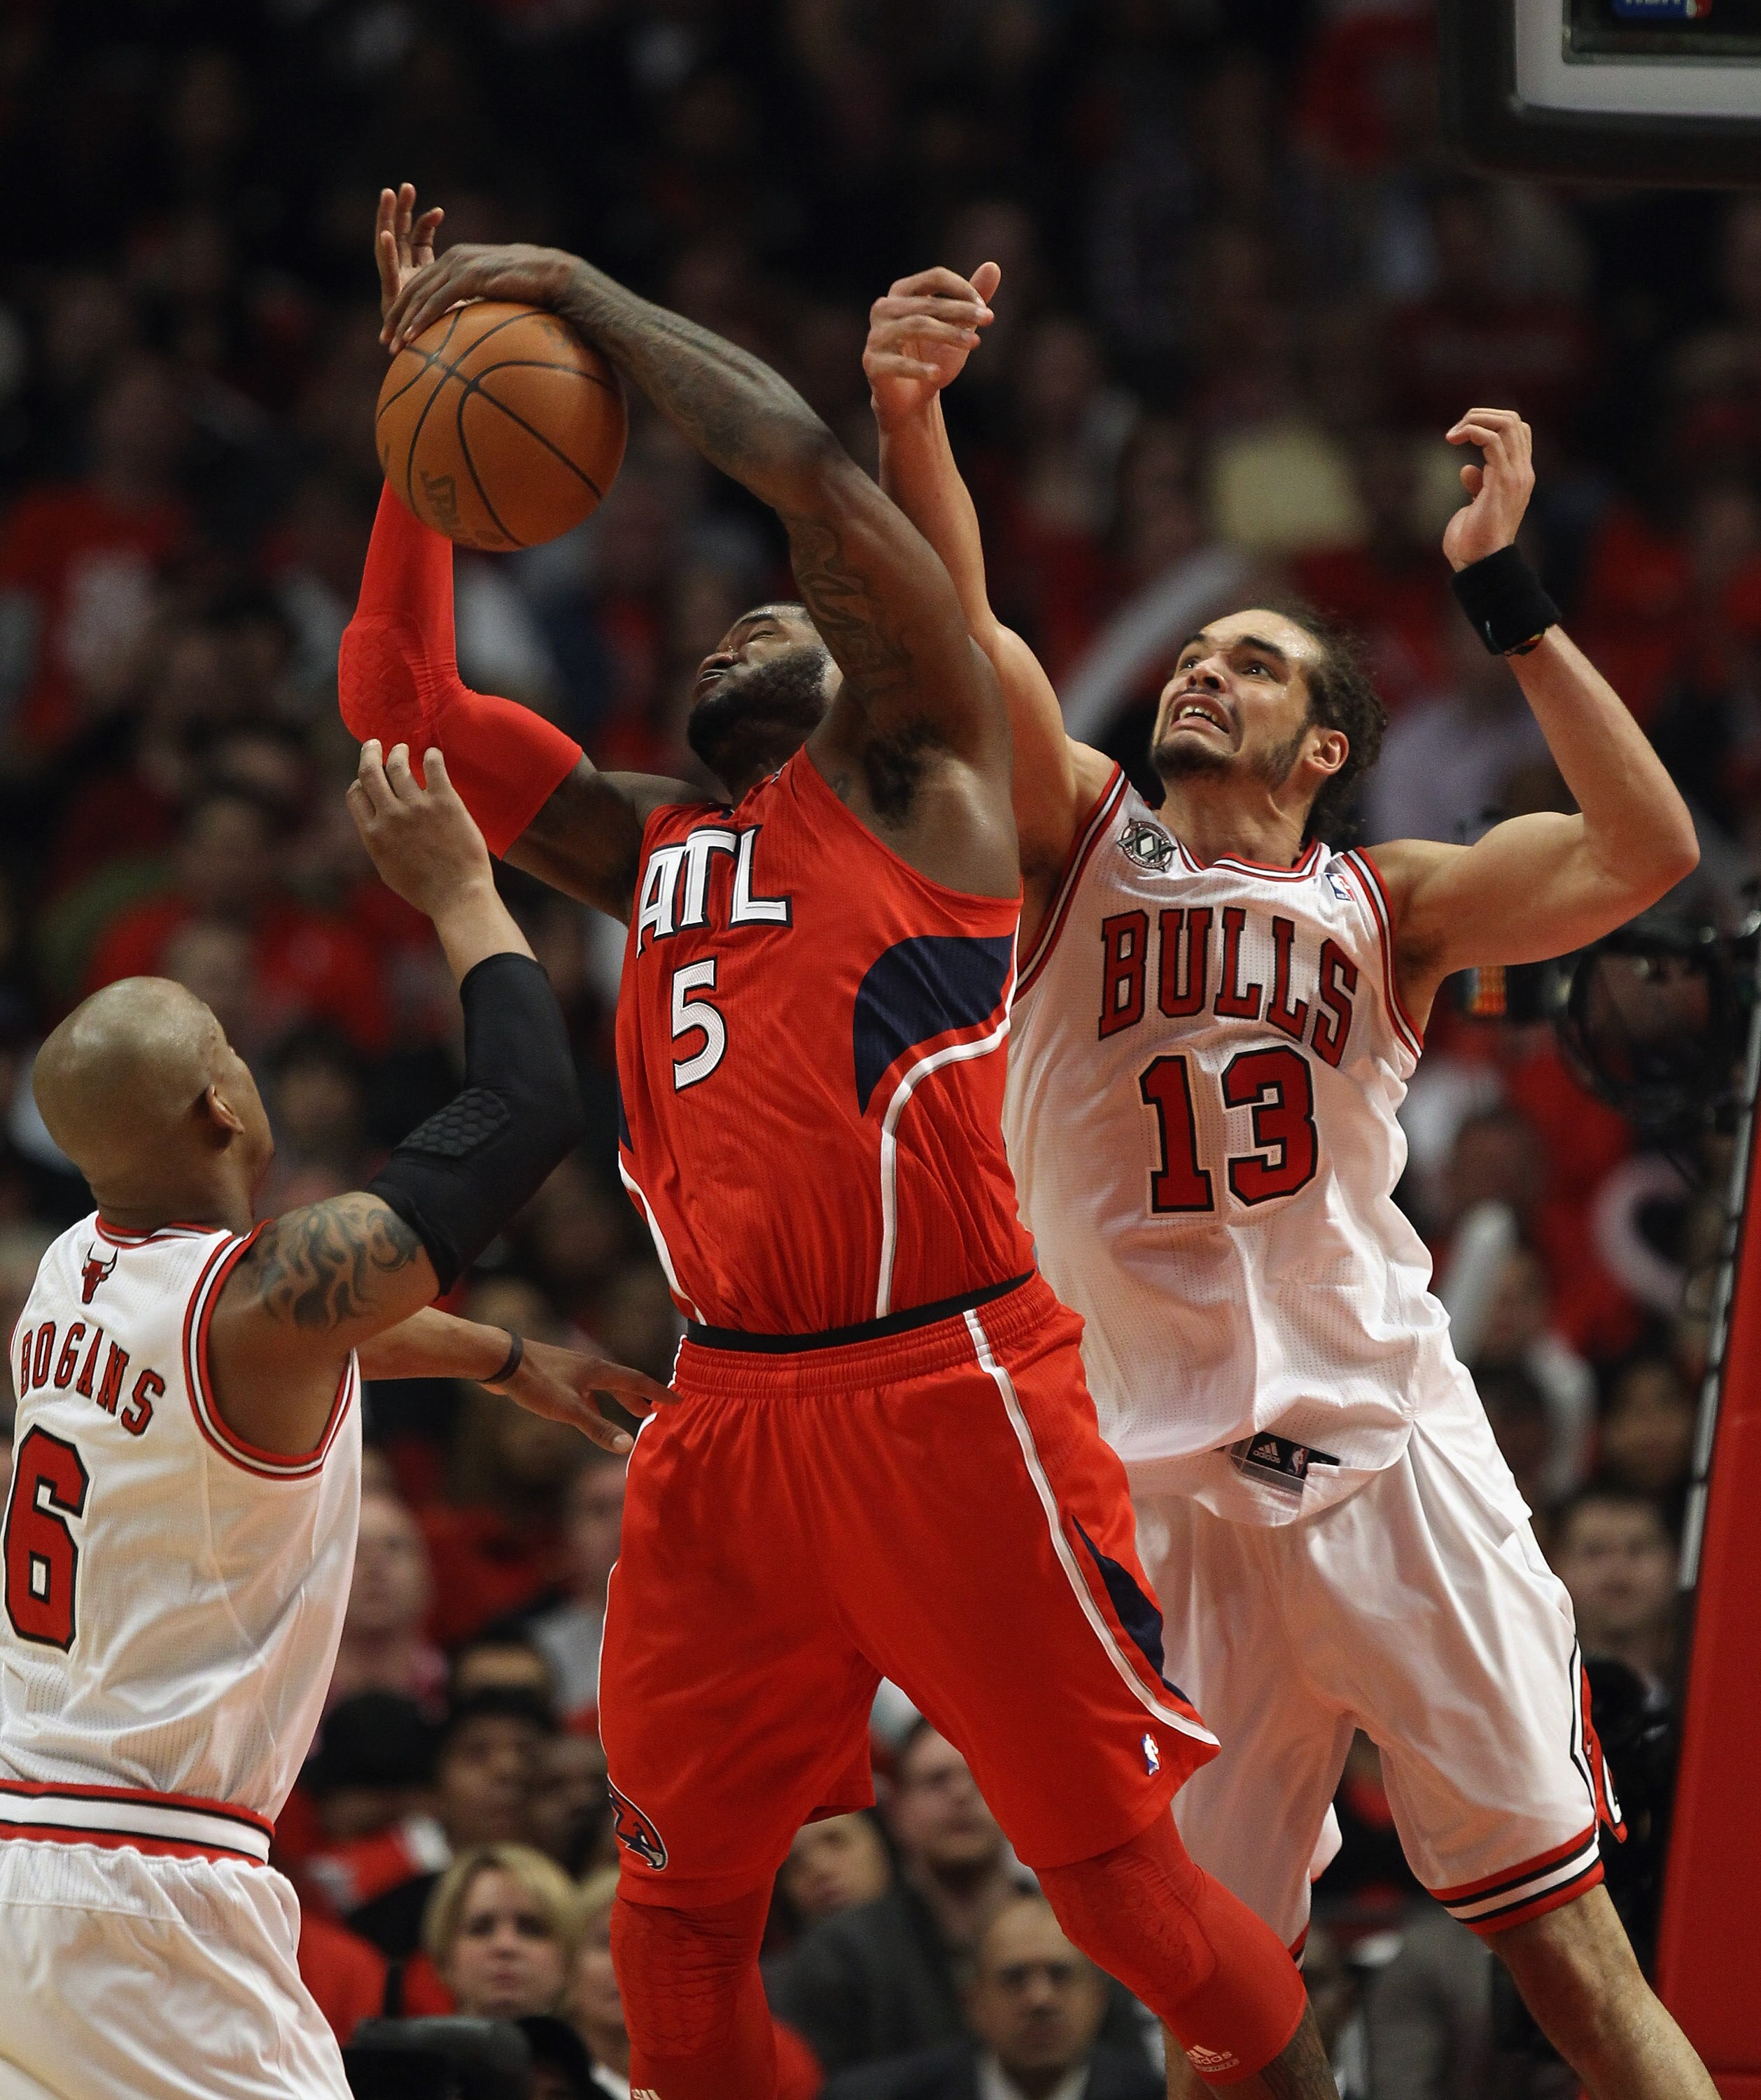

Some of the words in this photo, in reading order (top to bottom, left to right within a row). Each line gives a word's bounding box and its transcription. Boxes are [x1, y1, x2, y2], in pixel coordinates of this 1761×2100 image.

[636, 824, 792, 958] ATL
[671, 955, 728, 1094] 5
[1099, 906, 1359, 1068] BULLS
[1139, 1044, 1319, 1213] 13
[20, 1321, 165, 1436] BOGANS
[1253, 1450, 1281, 1464] adidas
[3, 1423, 90, 1655] 6
